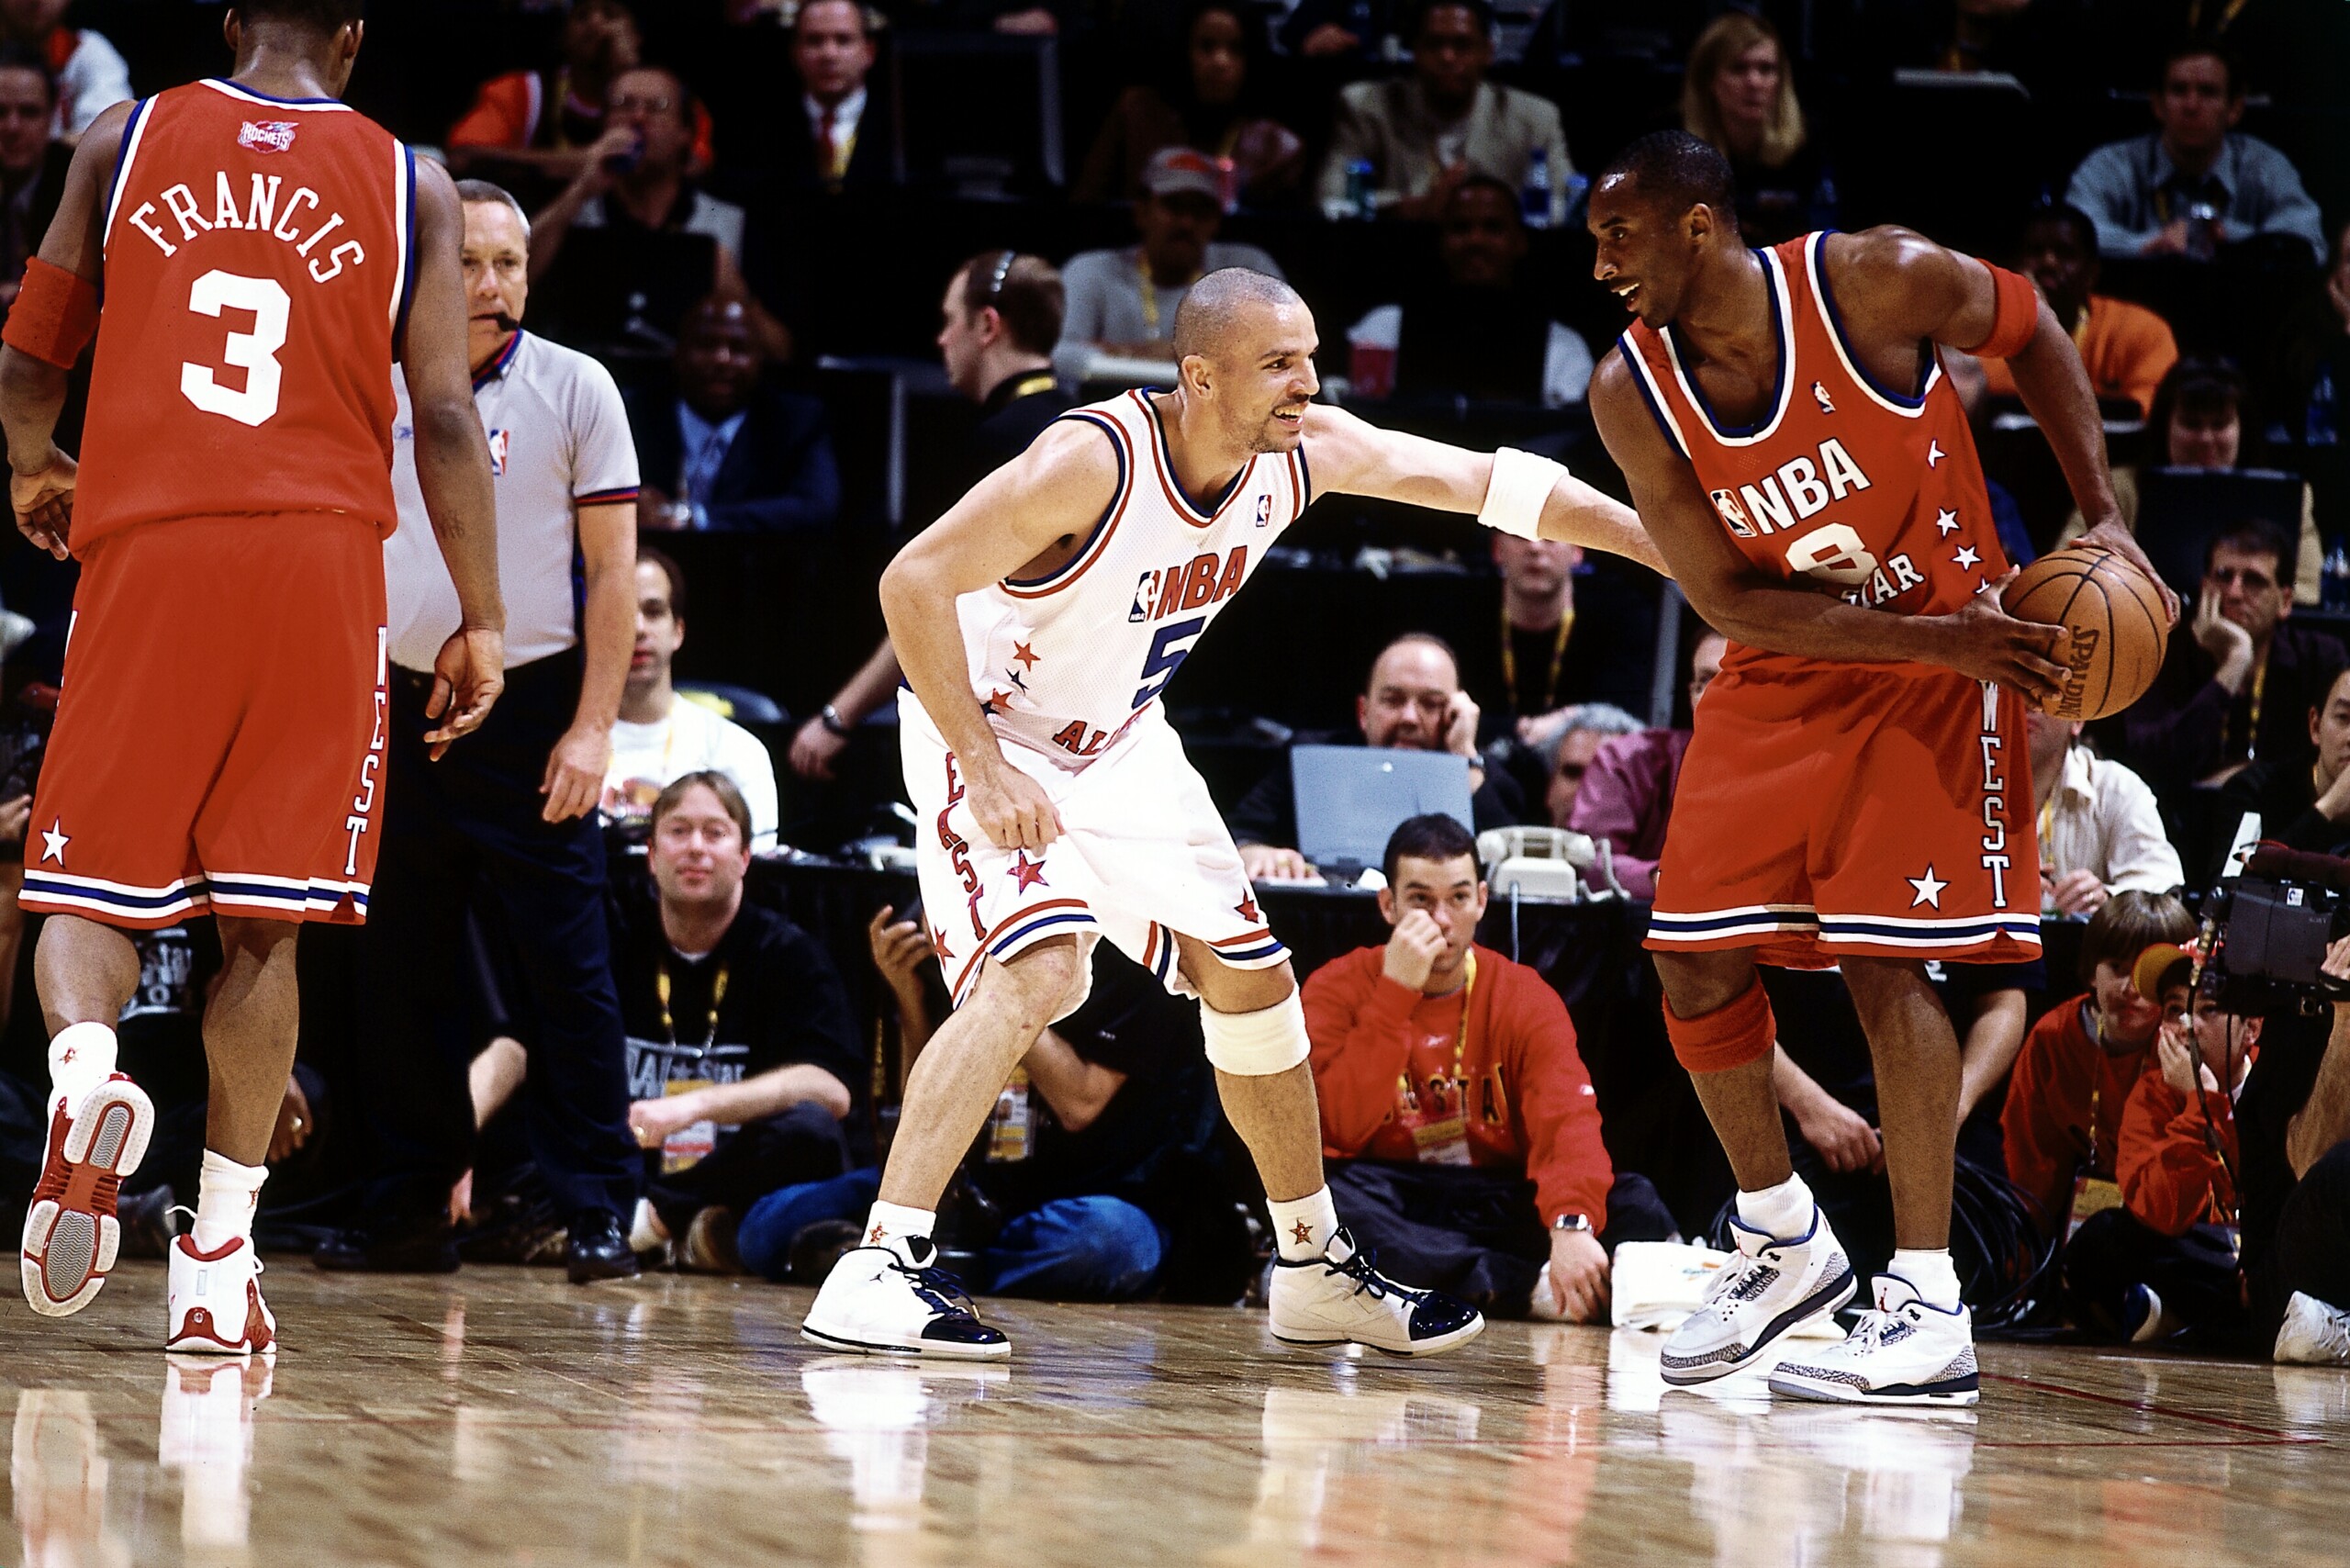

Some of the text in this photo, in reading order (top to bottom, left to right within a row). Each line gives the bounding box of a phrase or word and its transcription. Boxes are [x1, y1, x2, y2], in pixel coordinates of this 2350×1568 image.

[243, 122, 290, 149] ROCKETS
[129, 171, 365, 284] FRANCIS
[181, 269, 292, 427] 3
[1739, 437, 1873, 534] NBA
[1154, 544, 1248, 621] NBA
[1785, 522, 1878, 585] 8
[1131, 616, 1207, 711] 5
